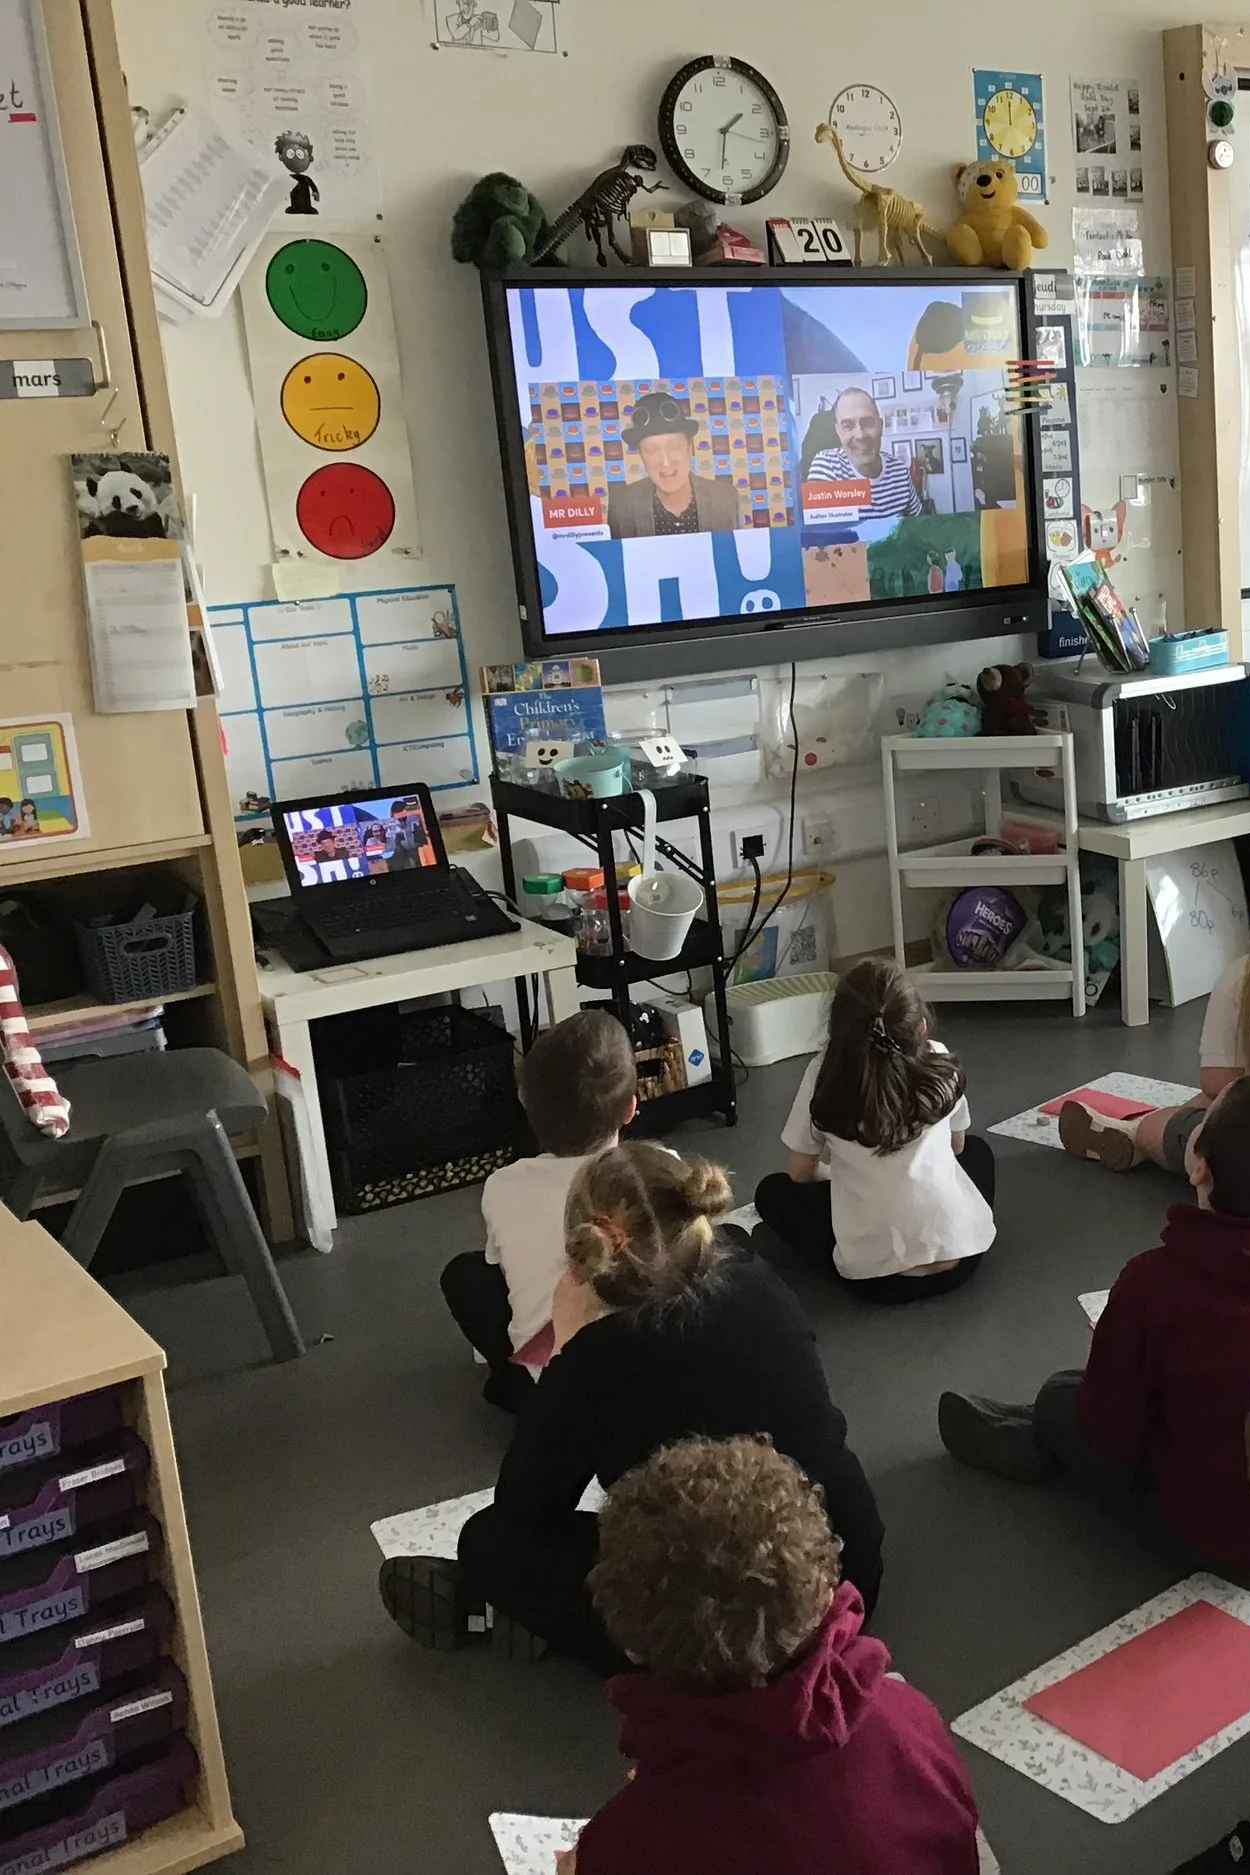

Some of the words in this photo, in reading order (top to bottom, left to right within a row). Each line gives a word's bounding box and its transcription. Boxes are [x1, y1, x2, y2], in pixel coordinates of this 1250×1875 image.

[713, 76, 726, 87] 12
[694, 83, 702, 93] 11
[861, 89, 870, 98] 12
[846, 92, 854, 101] 11
[680, 101, 693, 112] 10
[752, 104, 762, 114] 2
[836, 104, 845, 113] 10
[889, 111, 895, 120] 2
[676, 124, 687, 135] 9
[833, 120, 838, 129] 9
[760, 128, 769, 138] 3
[893, 127, 898, 136] 3
[684, 149, 695, 159] 8
[849, 153, 854, 161] 7
[864, 160, 869, 168] 6
[880, 156, 885, 165] 5
[700, 168, 711, 178] 7
[741, 169, 752, 179] 5
[722, 175, 734, 186] 6
[1021, 175, 1039, 191] 00
[797, 228, 843, 253] 20
[1034, 280, 1057, 294] jeudi
[1034, 301, 1066, 313] hursday
[12, 373, 62, 388] mars
[314, 423, 361, 447] Tricky
[808, 491, 832, 501] Justin
[834, 488, 866, 499] Worsley
[549, 509, 566, 519] MR
[568, 506, 595, 518] DILLY
[1059, 635, 1088, 648] finishe
[514, 699, 580, 716] Children's
[1190, 862, 1218, 882] 86p
[974, 900, 1013, 935] HEROES
[1189, 910, 1214, 935] 80p
[0, 1432, 47, 1459] rays
[2, 1518, 66, 1547] Trays
[15, 1598, 78, 1628] Trays
